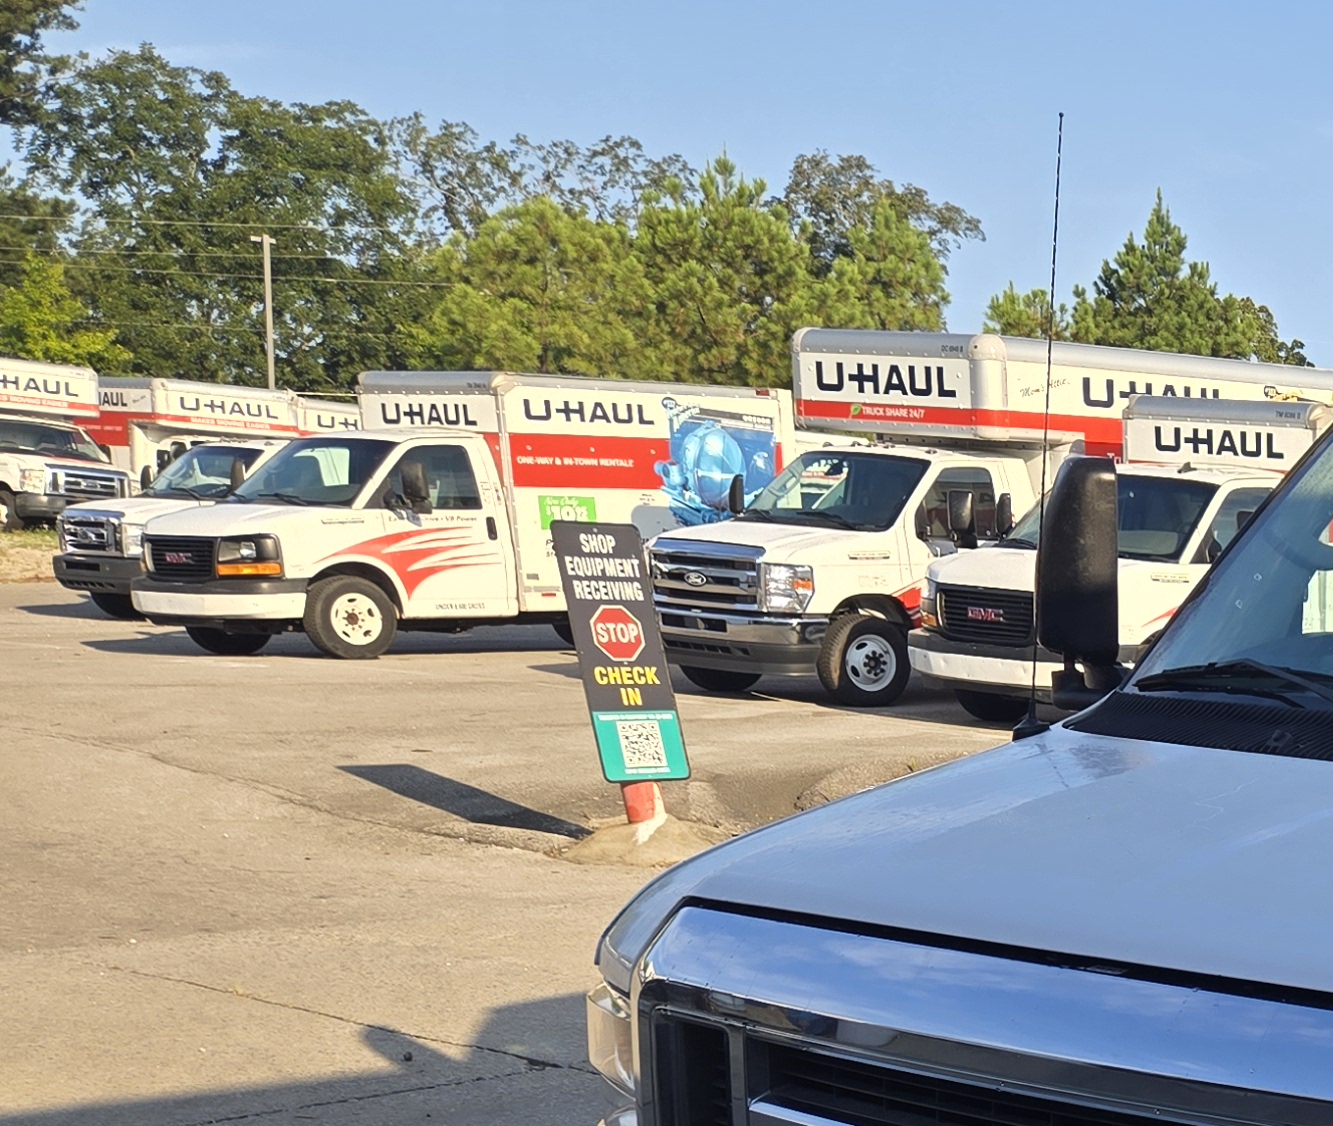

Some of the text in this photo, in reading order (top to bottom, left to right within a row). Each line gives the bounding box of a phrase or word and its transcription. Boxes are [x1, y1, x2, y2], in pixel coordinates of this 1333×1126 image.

[0, 374, 79, 397] HAUL
[816, 361, 957, 398] U-HAUL
[98, 391, 128, 407] AUL
[180, 396, 279, 420] U-HAUL
[317, 414, 359, 430] U-H
[380, 402, 478, 427] U-HAUL
[523, 398, 655, 425] U-HAUL
[862, 407, 925, 419] TRUCK SHARE 24/7
[1154, 425, 1285, 460] U-HAUL
[516, 456, 554, 466] ONE-WAY
[563, 457, 598, 466] IN-TOWN
[579, 533, 616, 554] SHOP
[564, 556, 640, 578] EQUIPMENT
[572, 580, 645, 601] RECEIVING
[596, 622, 639, 644] STOP
[593, 666, 661, 685] CHECK
[620, 687, 643, 706] IN
